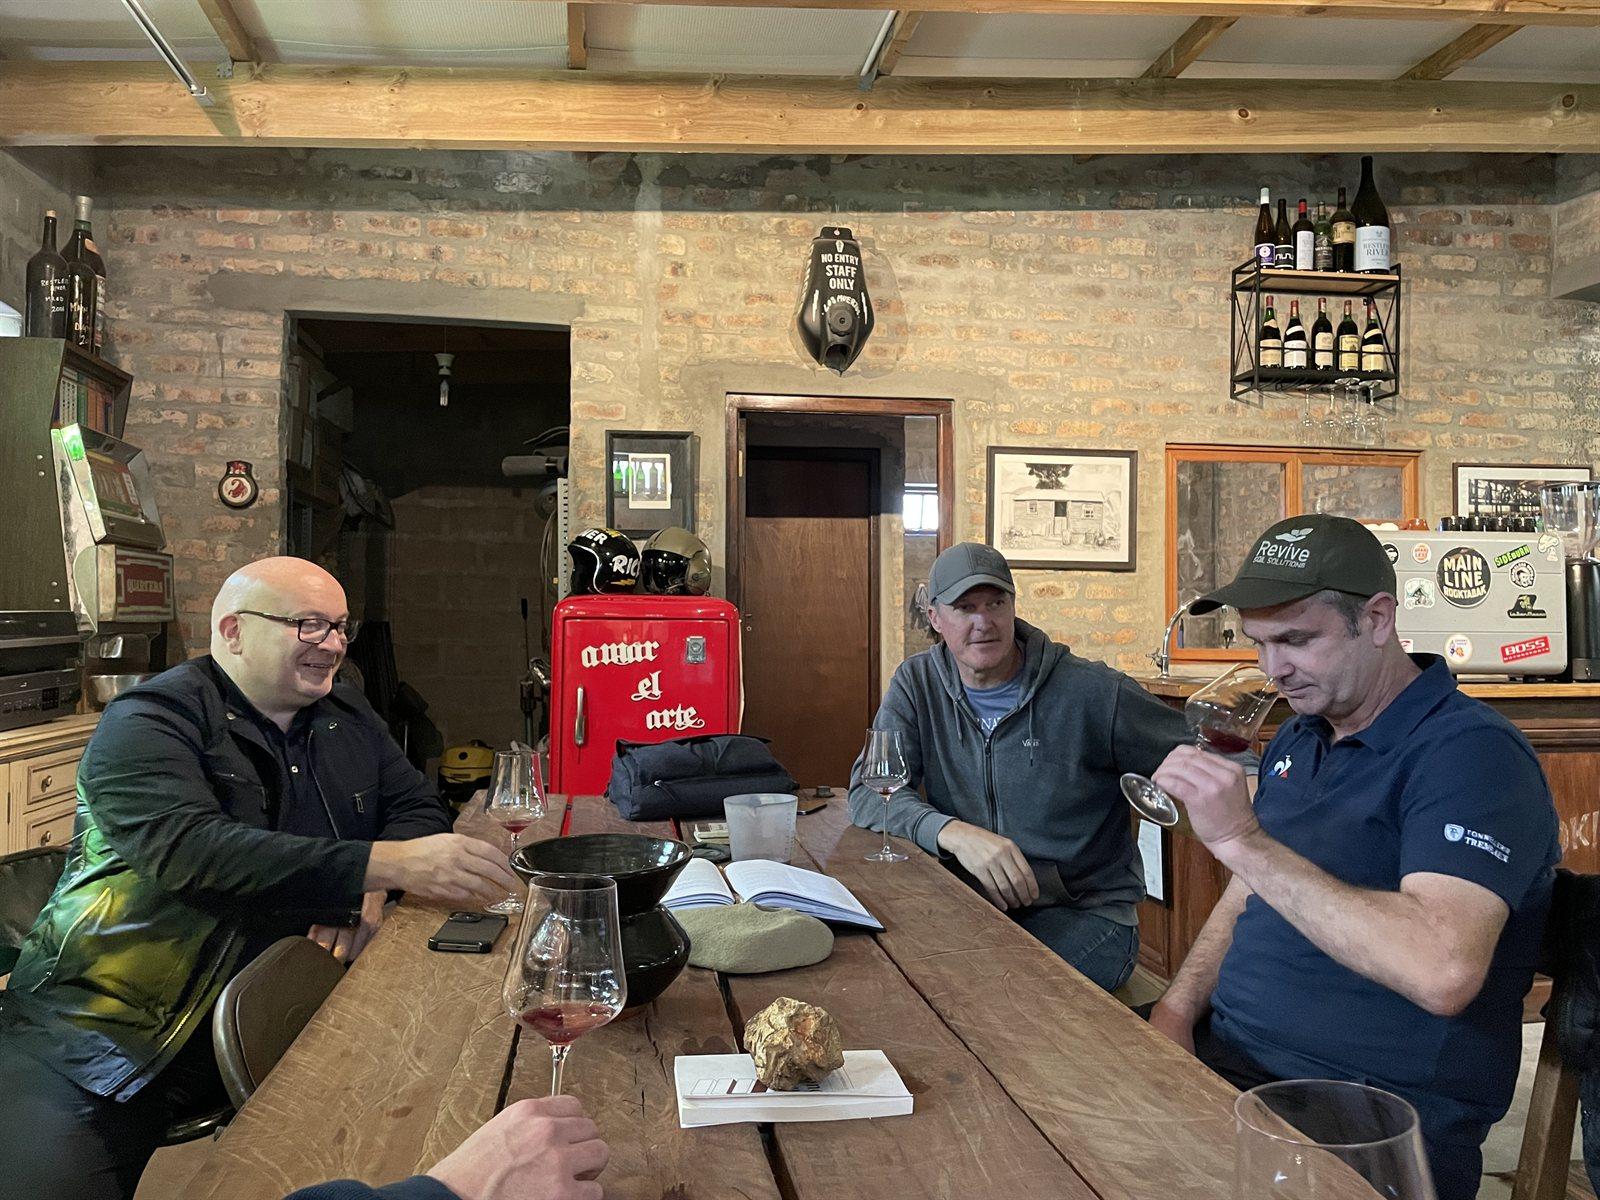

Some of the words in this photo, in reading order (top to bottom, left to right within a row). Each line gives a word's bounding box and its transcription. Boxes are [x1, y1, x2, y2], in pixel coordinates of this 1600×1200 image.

[821, 253, 833, 264] NO
[834, 253, 859, 265] ENTRY
[825, 264, 857, 278] STAFF
[829, 278, 855, 291] ONLY
[823, 296, 837, 313] LOS
[1256, 540, 1310, 562] Revive
[1494, 545, 1530, 567] SIDEBURN
[1266, 556, 1306, 569] SOLUTIONS
[1443, 554, 1482, 571] MAIN
[1444, 571, 1484, 588] LINE
[1504, 638, 1546, 656] BOSS
[631, 670, 663, 701] el
[646, 703, 705, 731] arte
